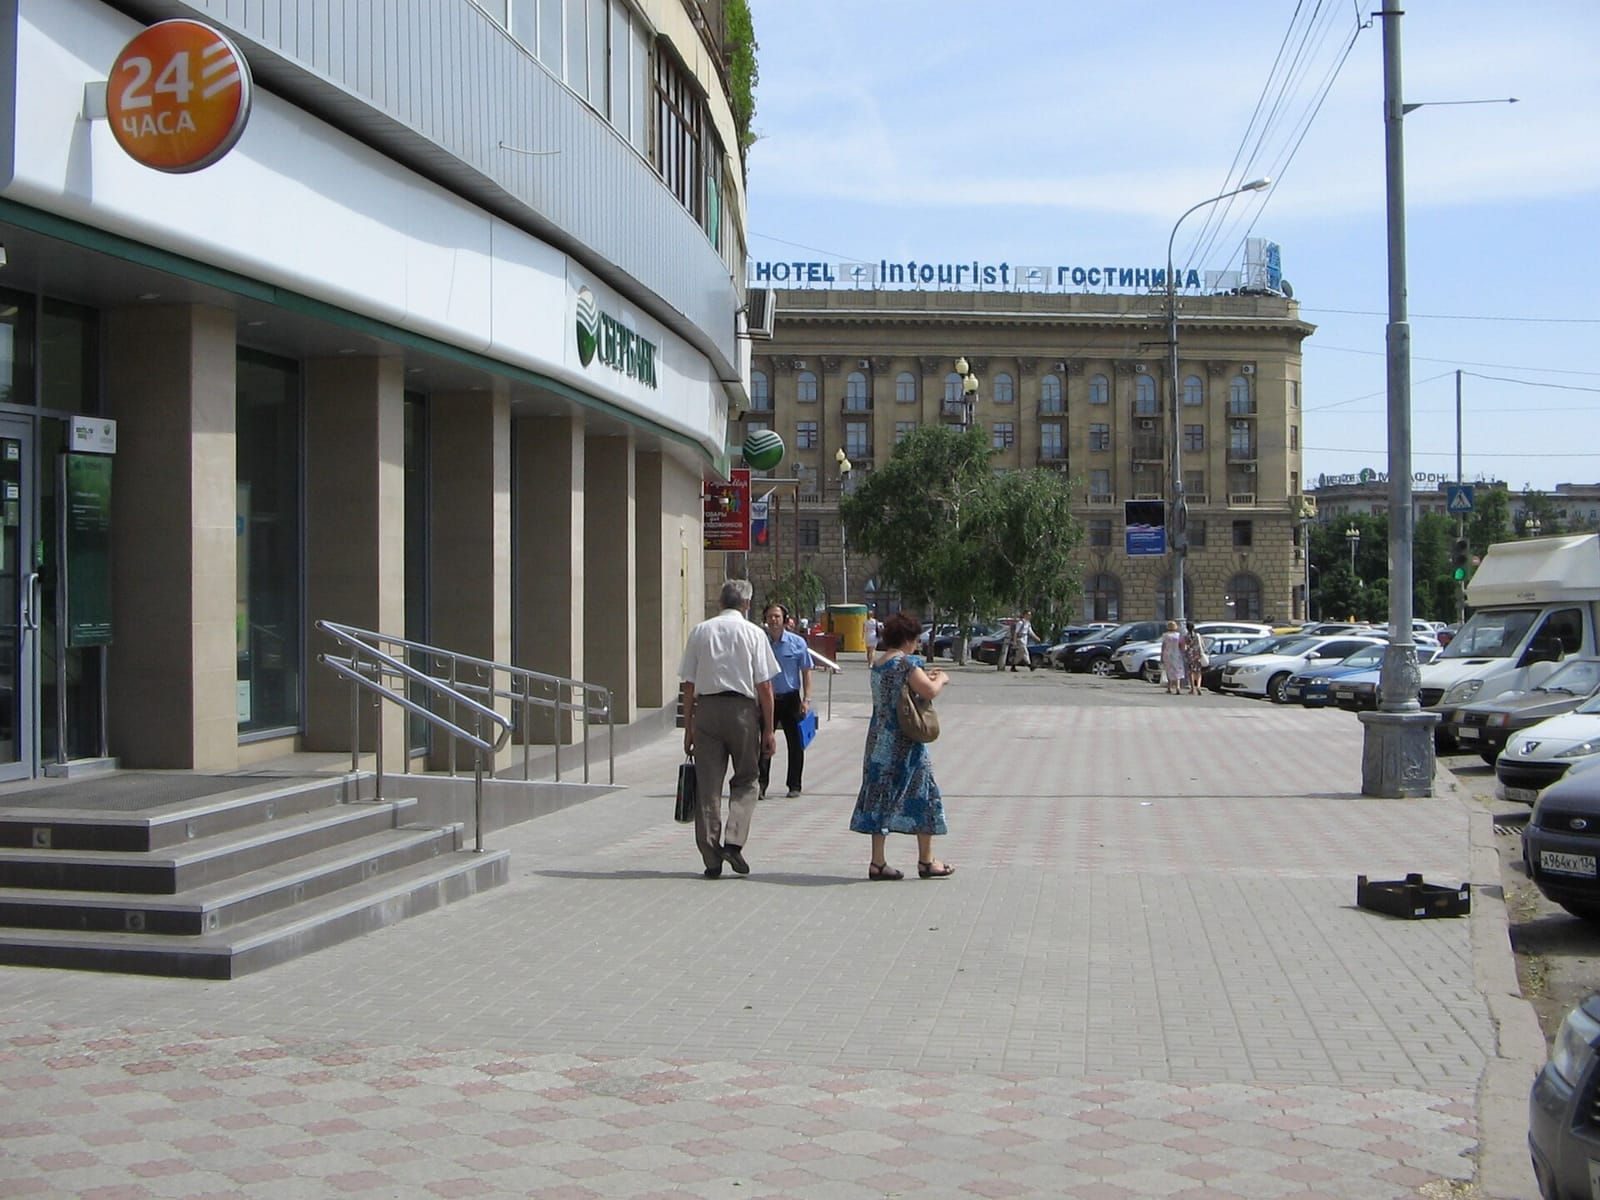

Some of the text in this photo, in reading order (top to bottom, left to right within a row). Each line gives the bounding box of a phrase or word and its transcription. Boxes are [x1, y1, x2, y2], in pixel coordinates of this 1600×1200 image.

[120, 51, 194, 111] 24
[121, 111, 197, 139] ЧАСА
[756, 261, 835, 282] HOTEL
[880, 259, 1009, 284] Intourist
[597, 311, 658, 390] СБЕРБАНК
